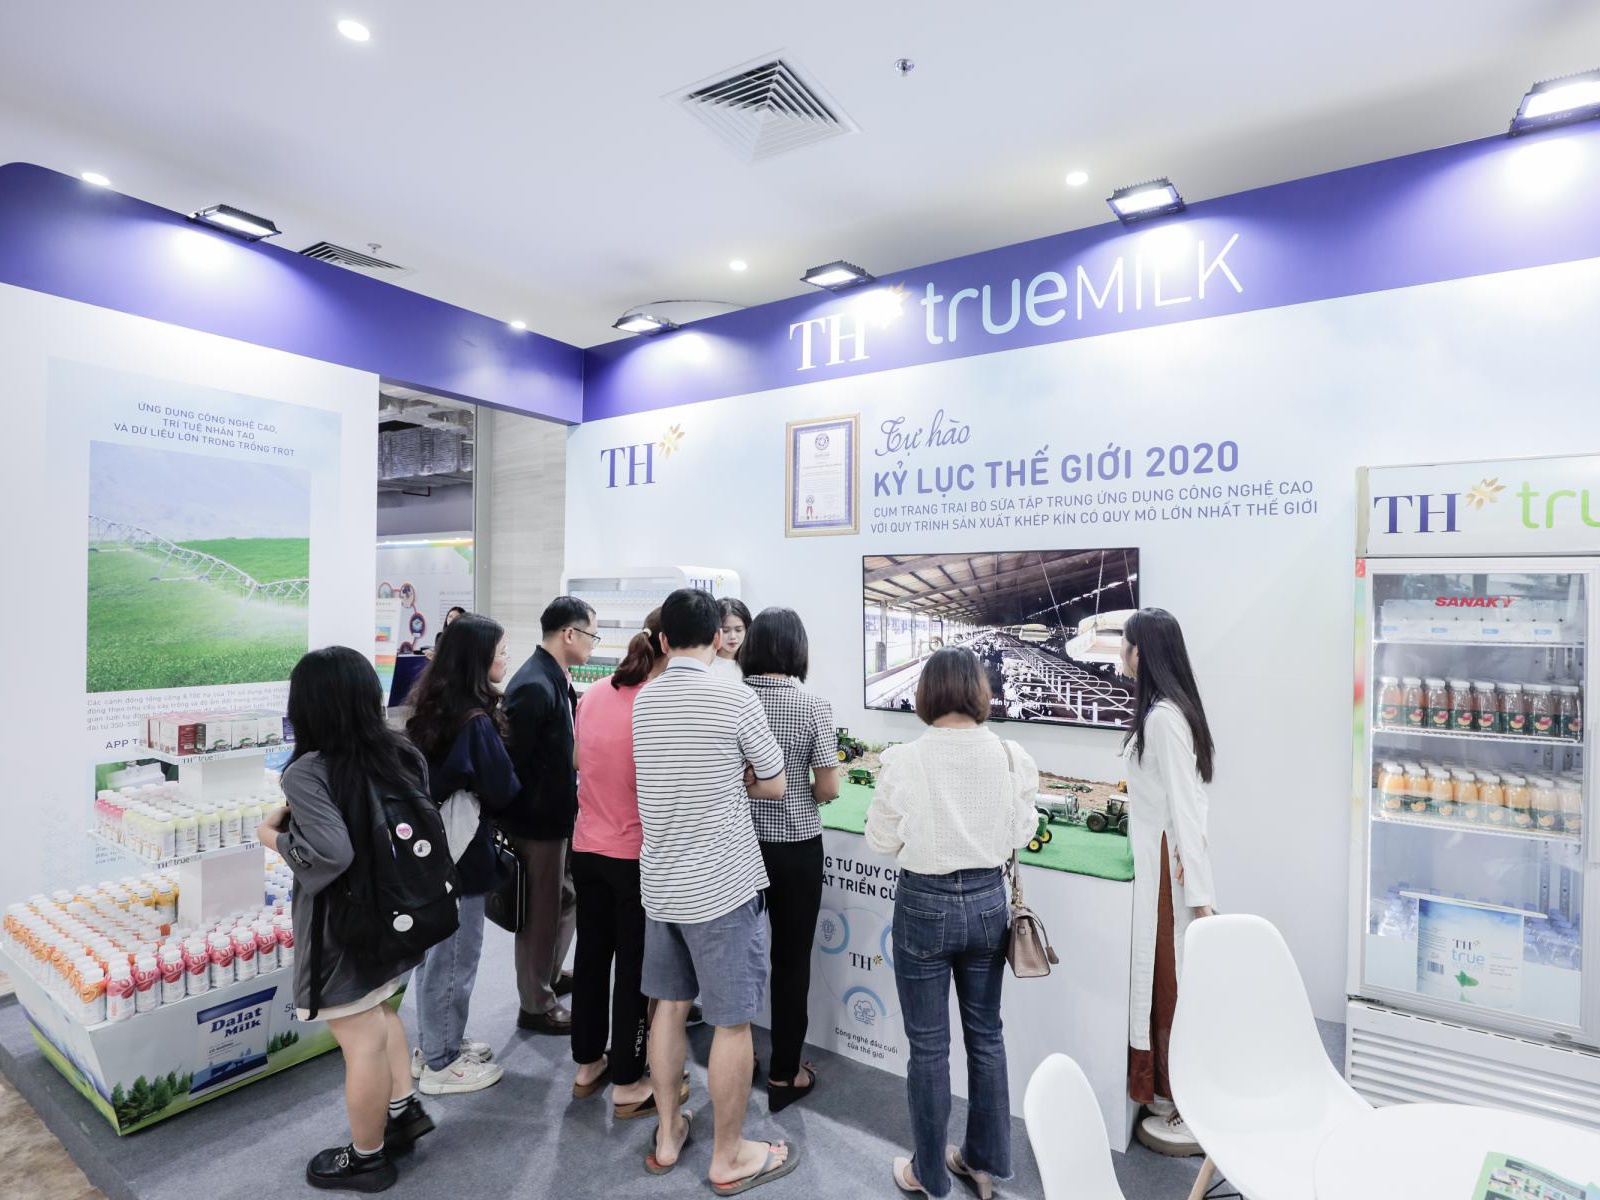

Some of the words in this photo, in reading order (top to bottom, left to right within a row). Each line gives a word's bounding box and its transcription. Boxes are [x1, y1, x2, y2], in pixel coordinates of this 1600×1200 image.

[789, 313, 871, 372] TH
[201, 435, 235, 448] TRONG
[874, 416, 923, 457] Tự
[925, 408, 971, 448] hào
[600, 442, 656, 489] TH
[874, 461, 908, 498] KỶ
[917, 463, 975, 498] LỤC
[984, 444, 1049, 489] THẾ
[1061, 442, 1132, 484] GIỚI
[1146, 440, 1239, 478] 2020
[901, 503, 938, 516] TRANG
[970, 499, 987, 513] BÒ
[990, 497, 1015, 511] SỮA
[1045, 494, 1093, 508] TRUNG
[1097, 489, 1127, 505] ỨNG
[1132, 488, 1174, 504] DỤNG
[1178, 484, 1223, 500] CÔNG
[1228, 479, 1274, 498] NGHỆ
[1279, 480, 1313, 495] CAO
[890, 521, 912, 533] QUY
[914, 518, 949, 532] TRÌNH
[980, 513, 1011, 528] XUẤT
[1014, 512, 1049, 527] KHÉP
[1053, 510, 1076, 525] KÍN
[1080, 508, 1098, 524] CÓ
[1102, 509, 1130, 523] QUY
[1134, 506, 1157, 521] MÔ
[1162, 504, 1192, 521] LỚN
[1198, 500, 1241, 519] NHẤT
[1246, 497, 1279, 516] THẾ
[1284, 498, 1318, 515] GIỚI
[1373, 492, 1462, 535] TH
[1434, 595, 1515, 609] SANAKY
[105, 739, 129, 750] APP
[824, 856, 832, 868] G
[836, 858, 853, 872] TƯ
[855, 862, 881, 878] DUY
[884, 868, 900, 882] CH
[822, 870, 835, 887] ÁT
[838, 876, 876, 897] TRIỂN
[880, 884, 896, 901] CỦ
[848, 951, 873, 971] TH
[1452, 949, 1486, 965] true
[210, 1007, 262, 1034] Dalat
[224, 1020, 261, 1038] Milk
